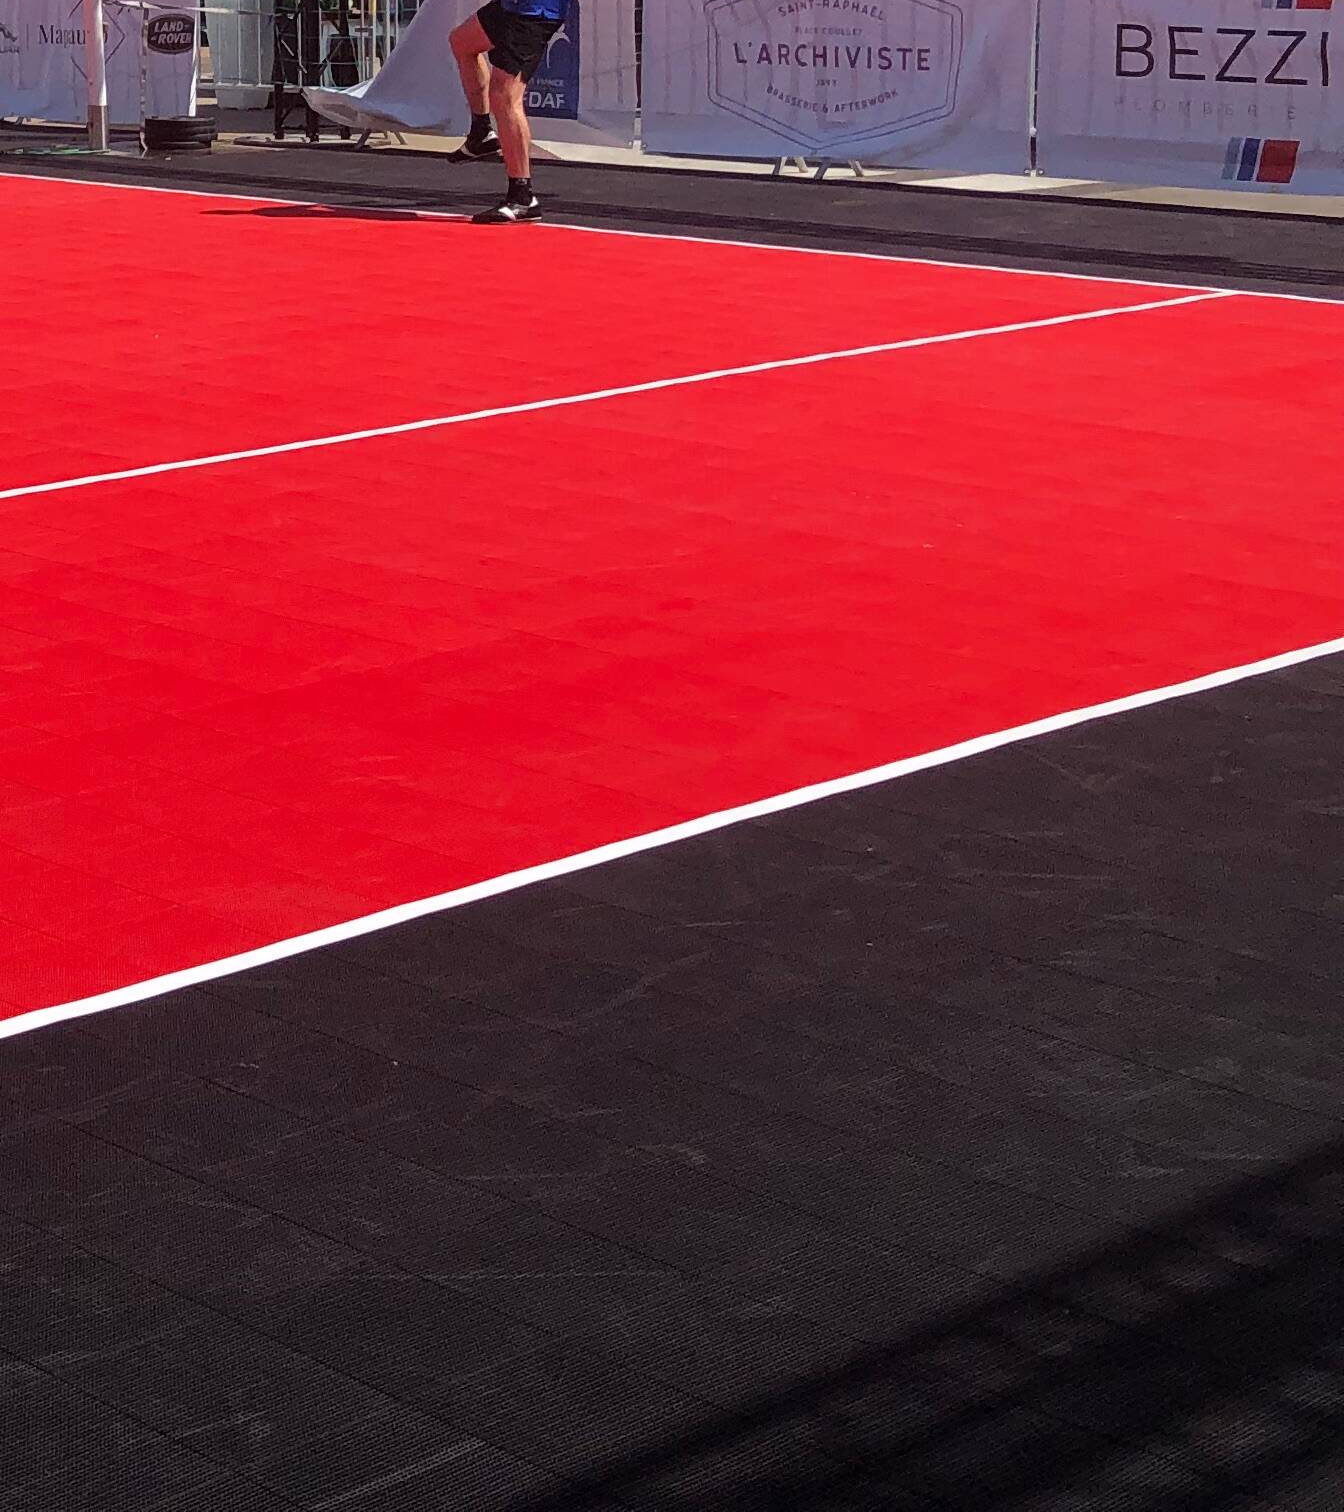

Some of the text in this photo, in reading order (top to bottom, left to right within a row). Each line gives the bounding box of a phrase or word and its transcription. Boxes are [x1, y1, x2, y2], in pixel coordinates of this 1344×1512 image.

[733, 42, 932, 72] L'ARCHIVISTE
[1115, 23, 1330, 87] BEZZI
[833, 88, 899, 114] AFTERWORK
